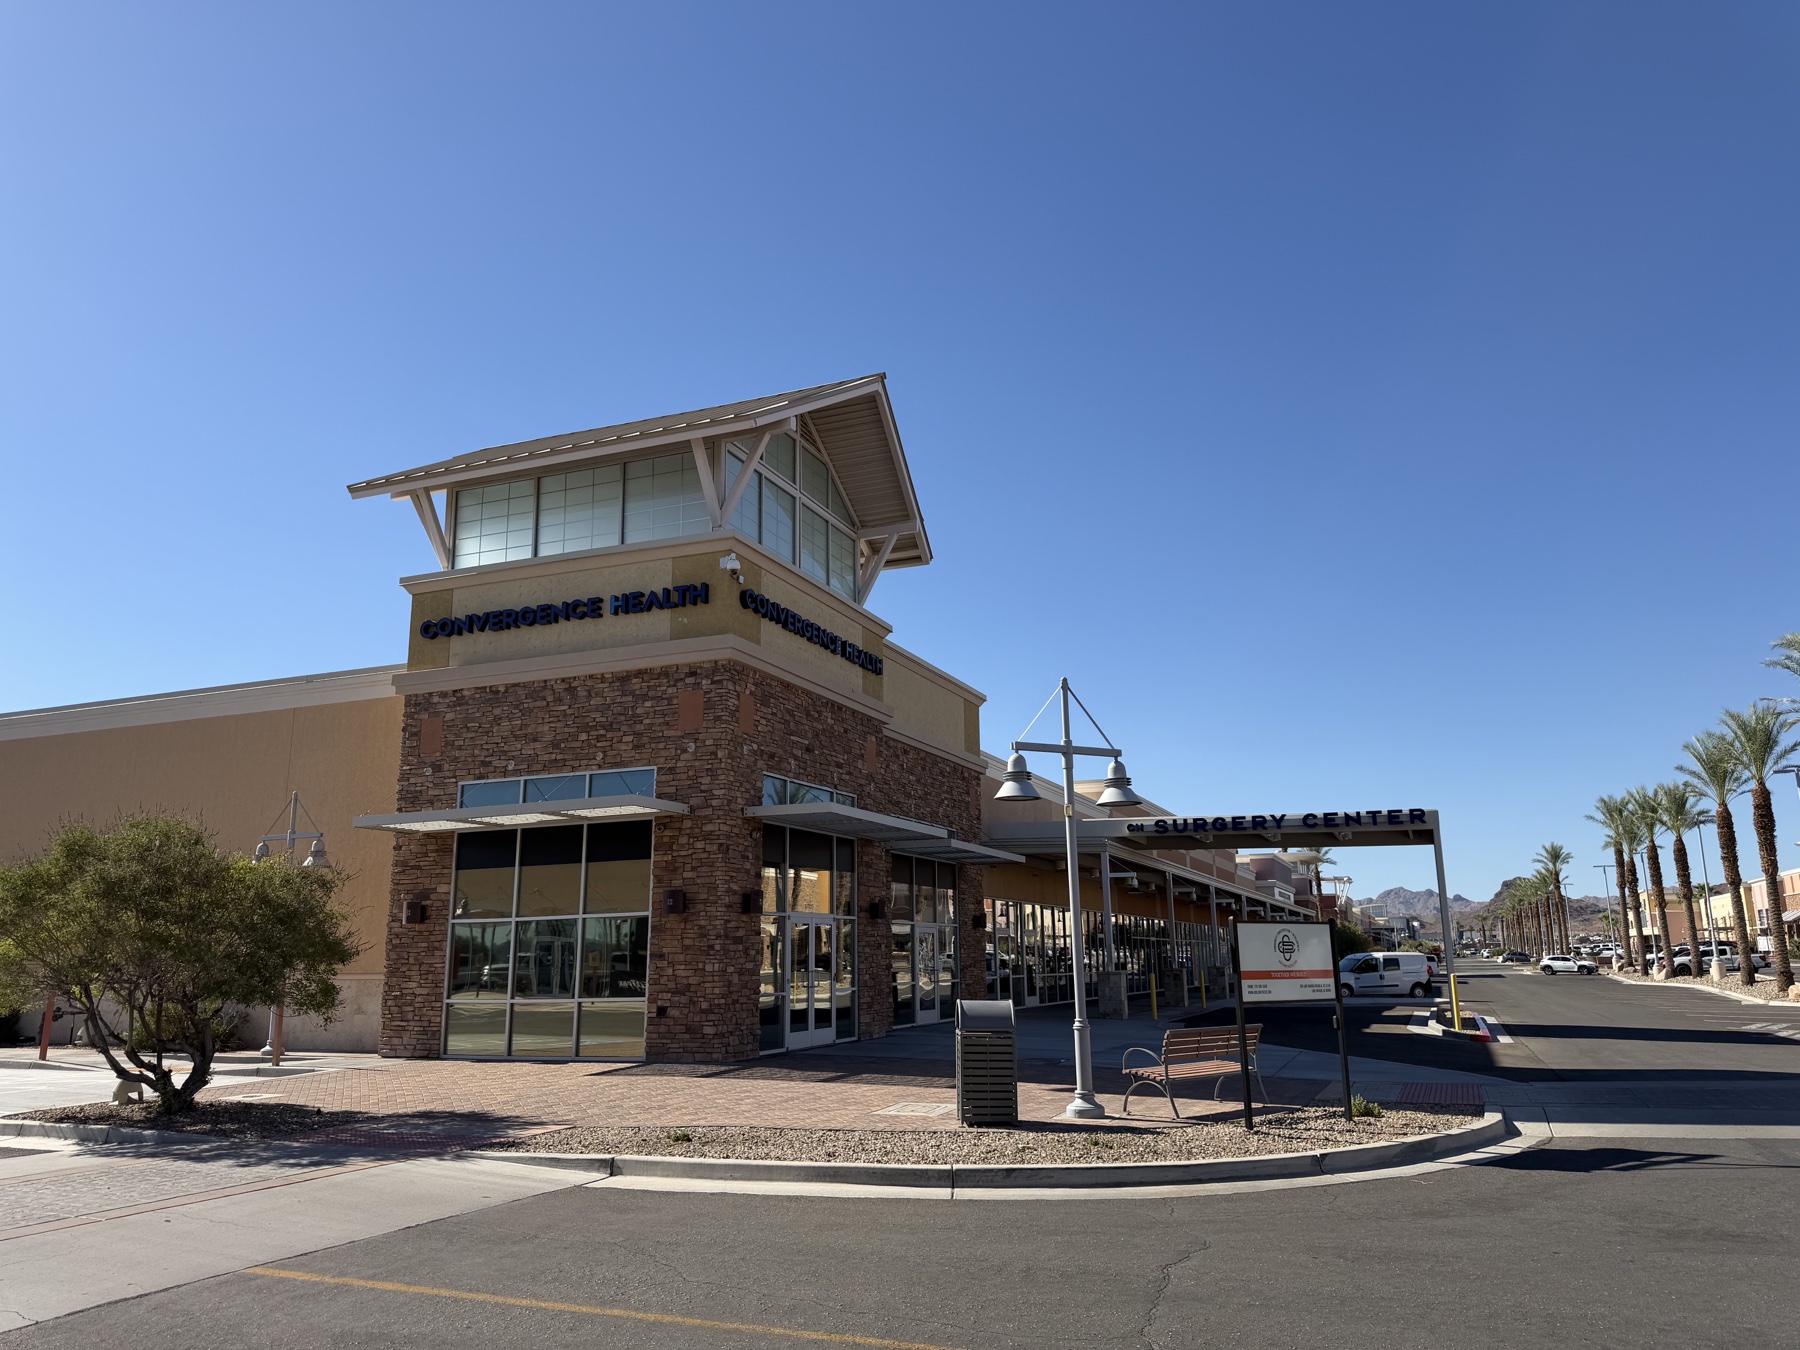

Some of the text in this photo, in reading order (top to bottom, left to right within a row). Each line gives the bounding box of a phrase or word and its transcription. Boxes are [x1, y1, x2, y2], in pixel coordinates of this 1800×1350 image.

[420, 582, 710, 640] CONVERGENCE HEALTH
[739, 588, 884, 676] CONVERGENCE HEALTH
[1126, 808, 1428, 834] CH SURGERY CENTER
